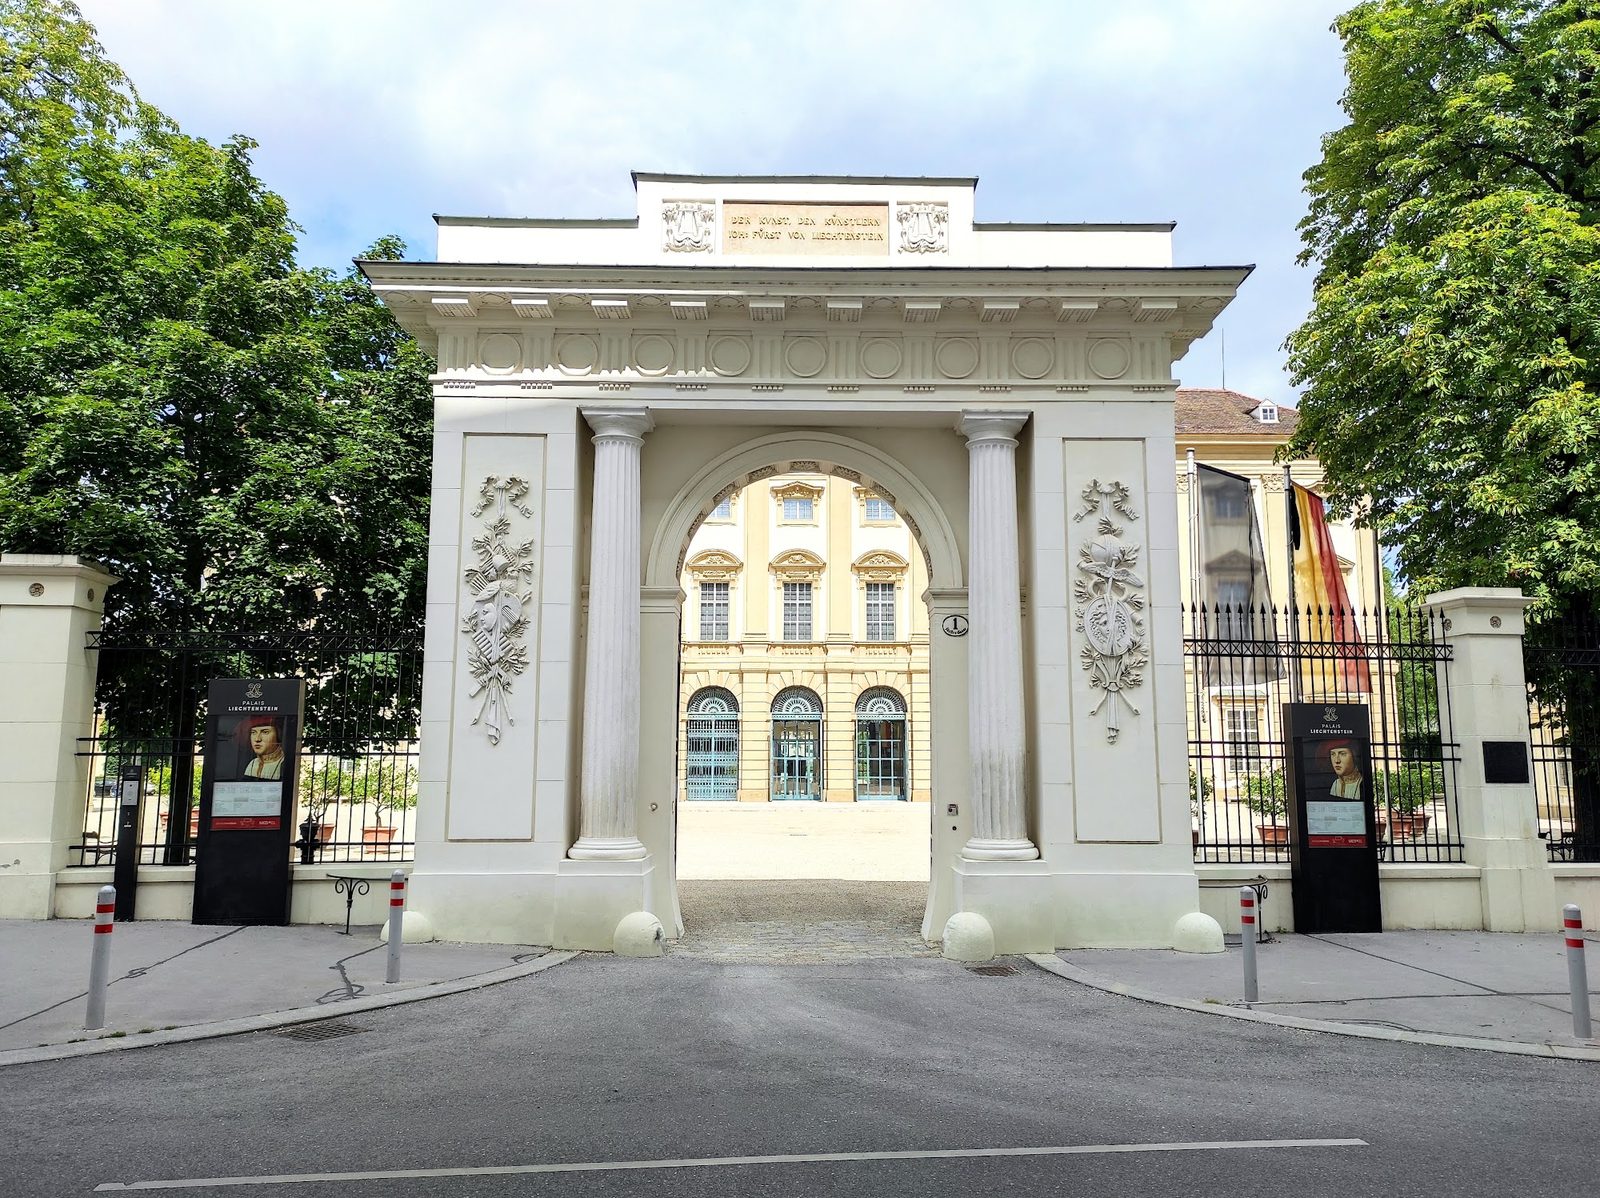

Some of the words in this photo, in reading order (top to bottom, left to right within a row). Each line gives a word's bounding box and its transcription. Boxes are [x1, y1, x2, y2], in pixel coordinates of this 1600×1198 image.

[731, 216, 751, 225] DER
[797, 217, 816, 226] DEN
[787, 231, 806, 240] VON
[811, 232, 884, 241] LIECHTENSTEIN
[952, 617, 959, 630] 1
